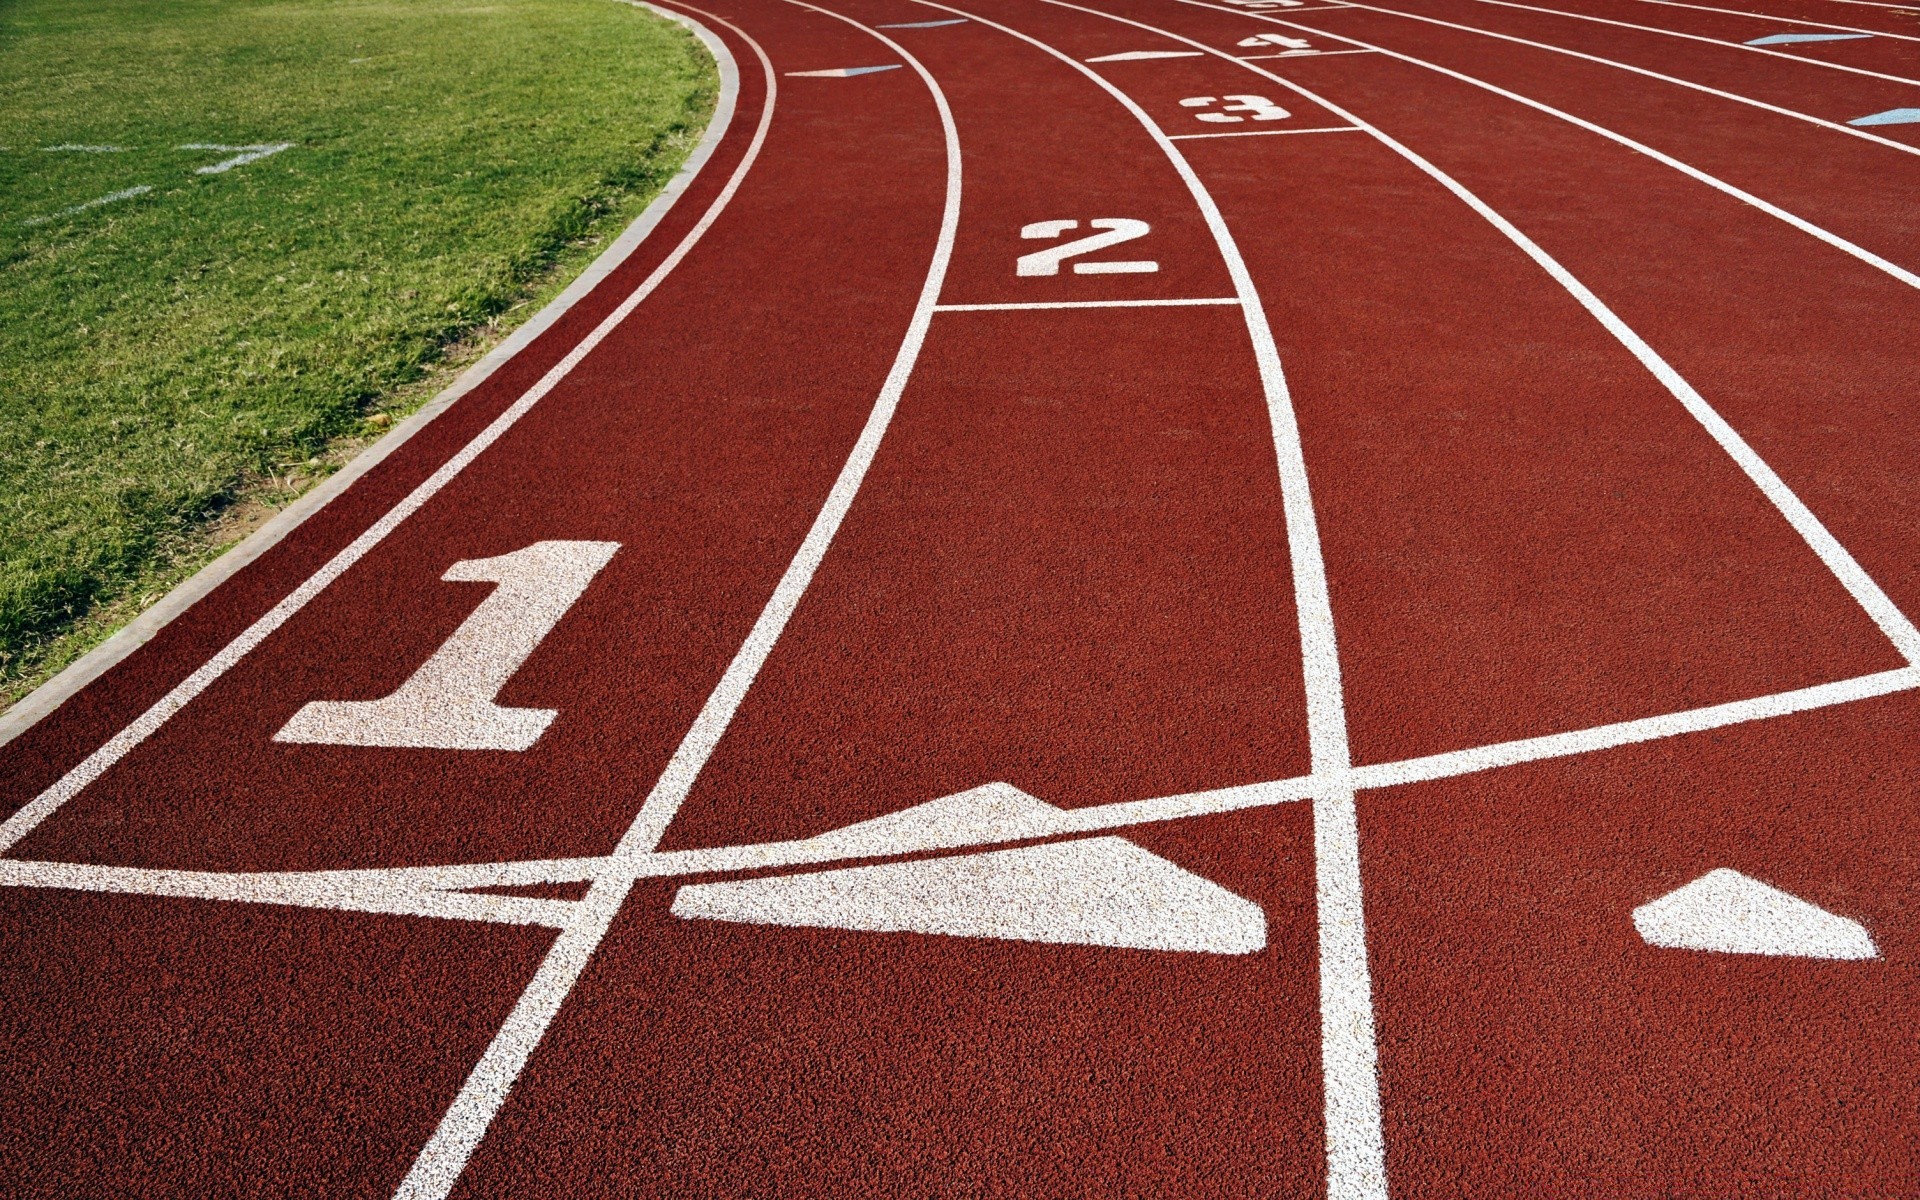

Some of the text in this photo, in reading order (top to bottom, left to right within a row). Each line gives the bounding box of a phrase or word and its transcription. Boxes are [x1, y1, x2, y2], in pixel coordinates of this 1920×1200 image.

[1237, 33, 1321, 55] 4
[1178, 94, 1292, 123] 3
[1016, 217, 1160, 277] 2
[272, 540, 623, 752] 1
